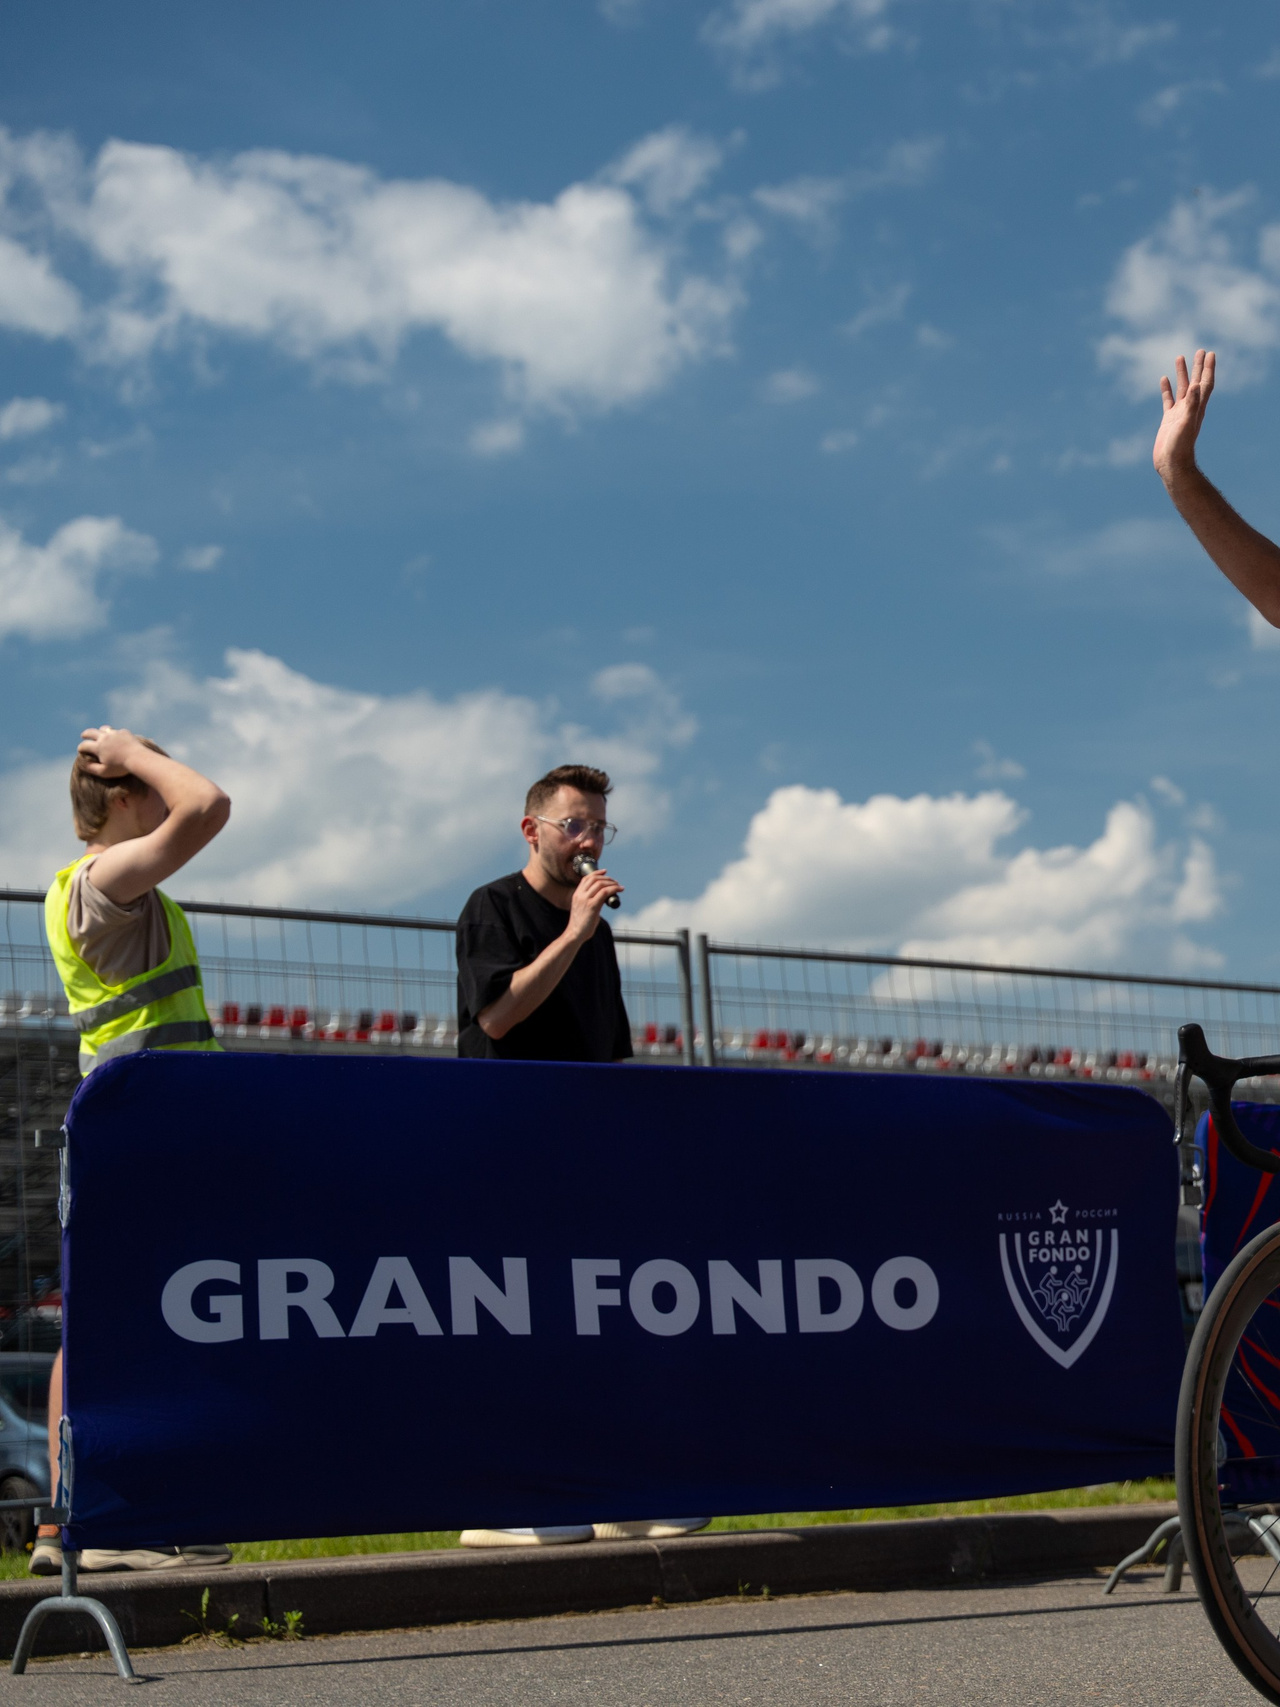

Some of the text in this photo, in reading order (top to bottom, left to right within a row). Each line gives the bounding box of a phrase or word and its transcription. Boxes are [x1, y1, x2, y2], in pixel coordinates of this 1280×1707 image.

[997, 1212, 1042, 1221] RUSSIA
[1075, 1208, 1118, 1218] РОССИЯ
[1027, 1229, 1089, 1246] GRAN
[1028, 1246, 1090, 1263] FONDO
[160, 1255, 940, 1344] GRAN FONDO
